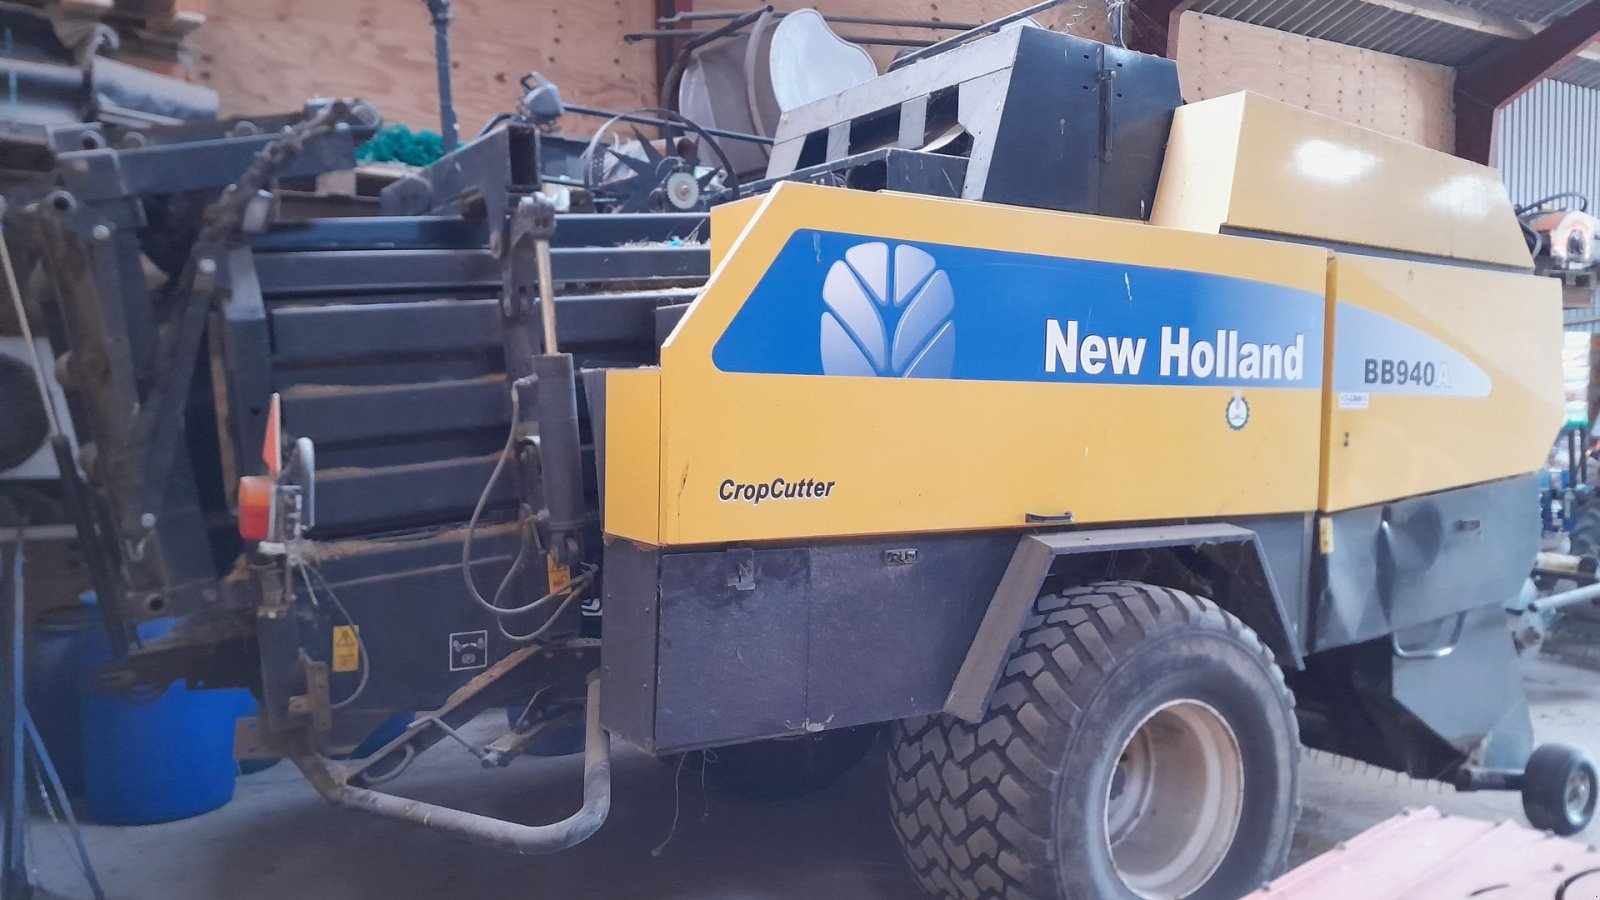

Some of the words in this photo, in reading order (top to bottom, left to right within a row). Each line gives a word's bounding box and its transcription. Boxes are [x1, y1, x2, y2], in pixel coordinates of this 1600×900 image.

[1044, 318, 1147, 376] New
[1159, 325, 1304, 380] Holland
[1364, 358, 1451, 388] BB940A
[719, 477, 836, 504] CropCutter
